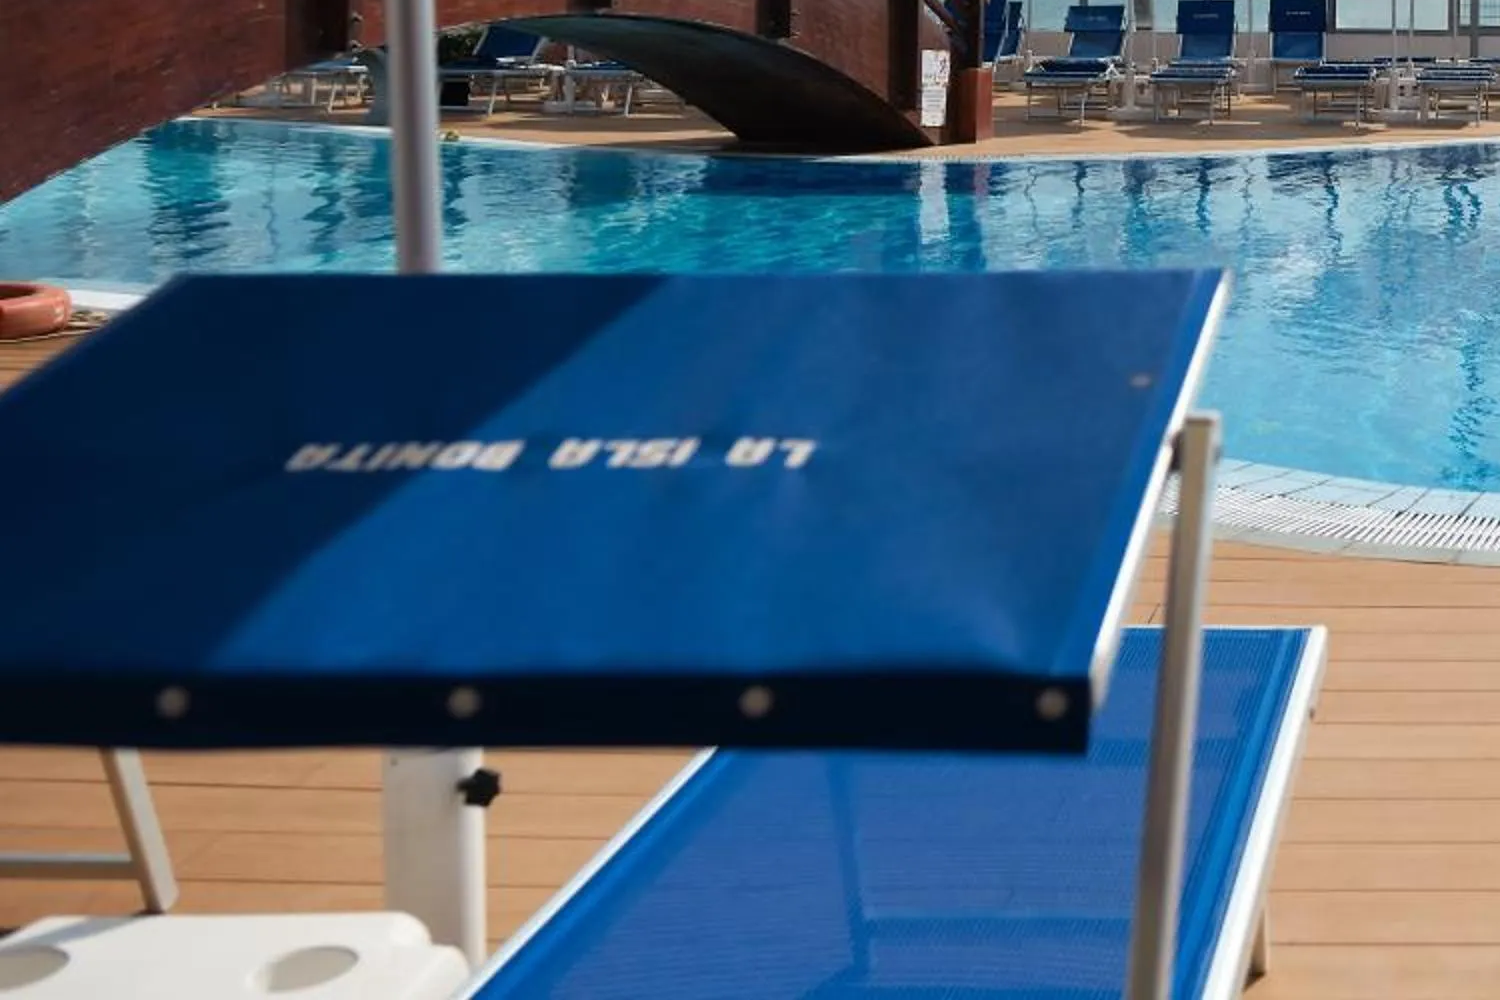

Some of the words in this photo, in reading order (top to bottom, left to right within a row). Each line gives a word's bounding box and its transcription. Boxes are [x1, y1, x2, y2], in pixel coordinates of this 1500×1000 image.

[285, 439, 526, 472] BONITA
[548, 436, 702, 470] ISLA
[725, 436, 818, 469] LA
